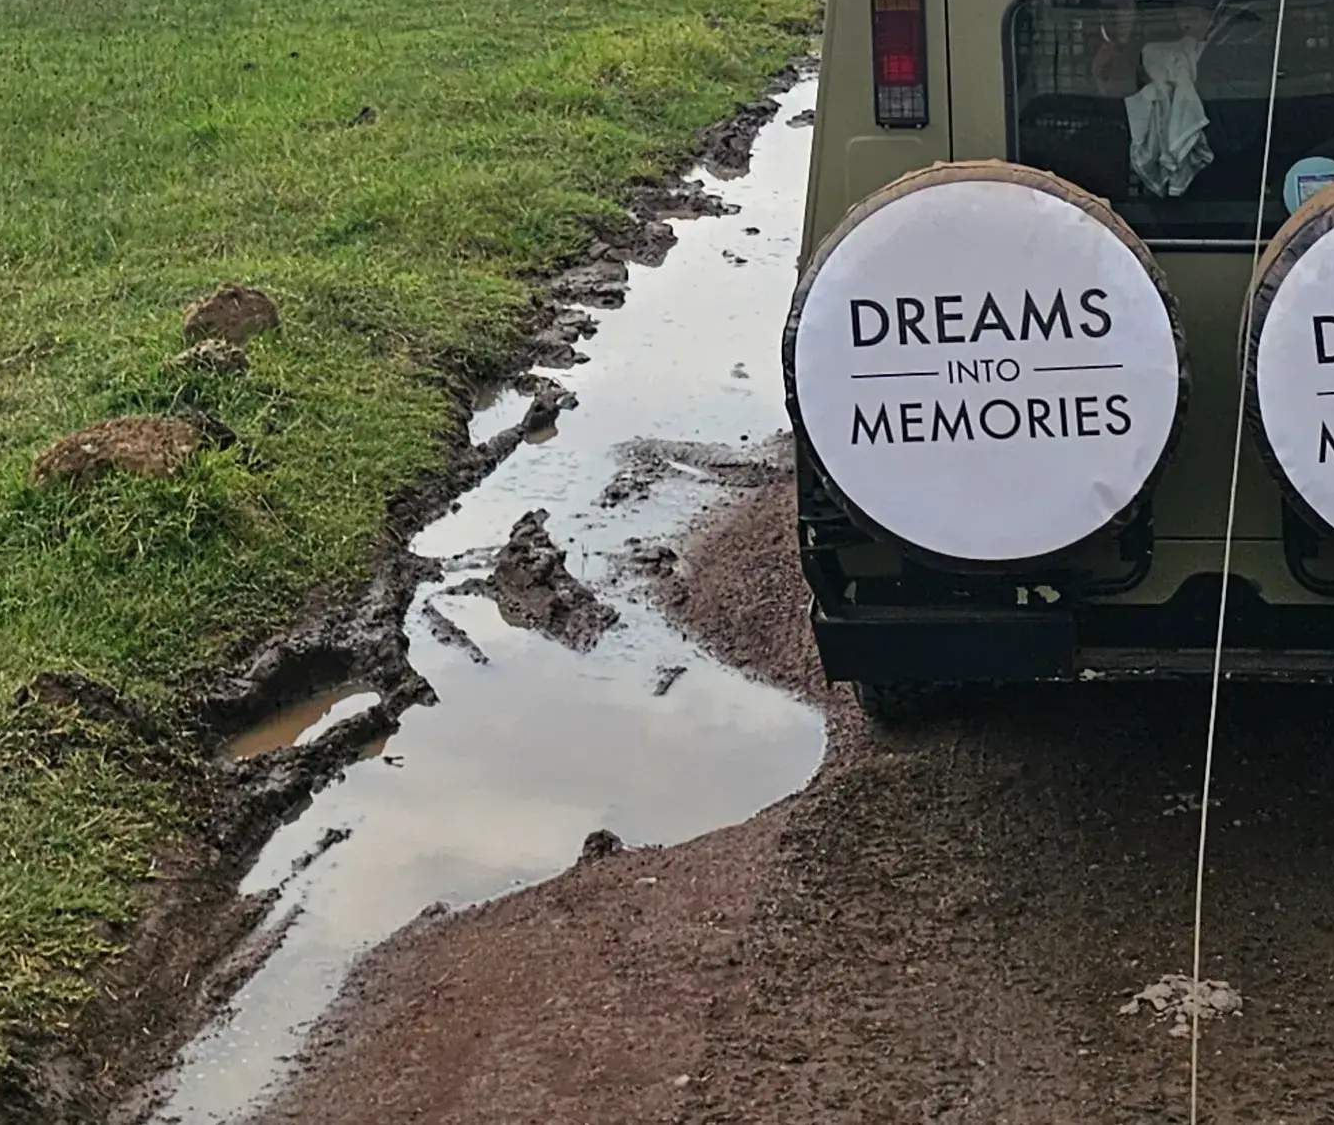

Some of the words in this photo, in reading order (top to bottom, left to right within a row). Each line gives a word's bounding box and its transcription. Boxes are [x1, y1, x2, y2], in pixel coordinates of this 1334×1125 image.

[850, 288, 1112, 347] DREAMS
[947, 358, 1021, 384] INTO
[850, 394, 1132, 445] MEMORIES
